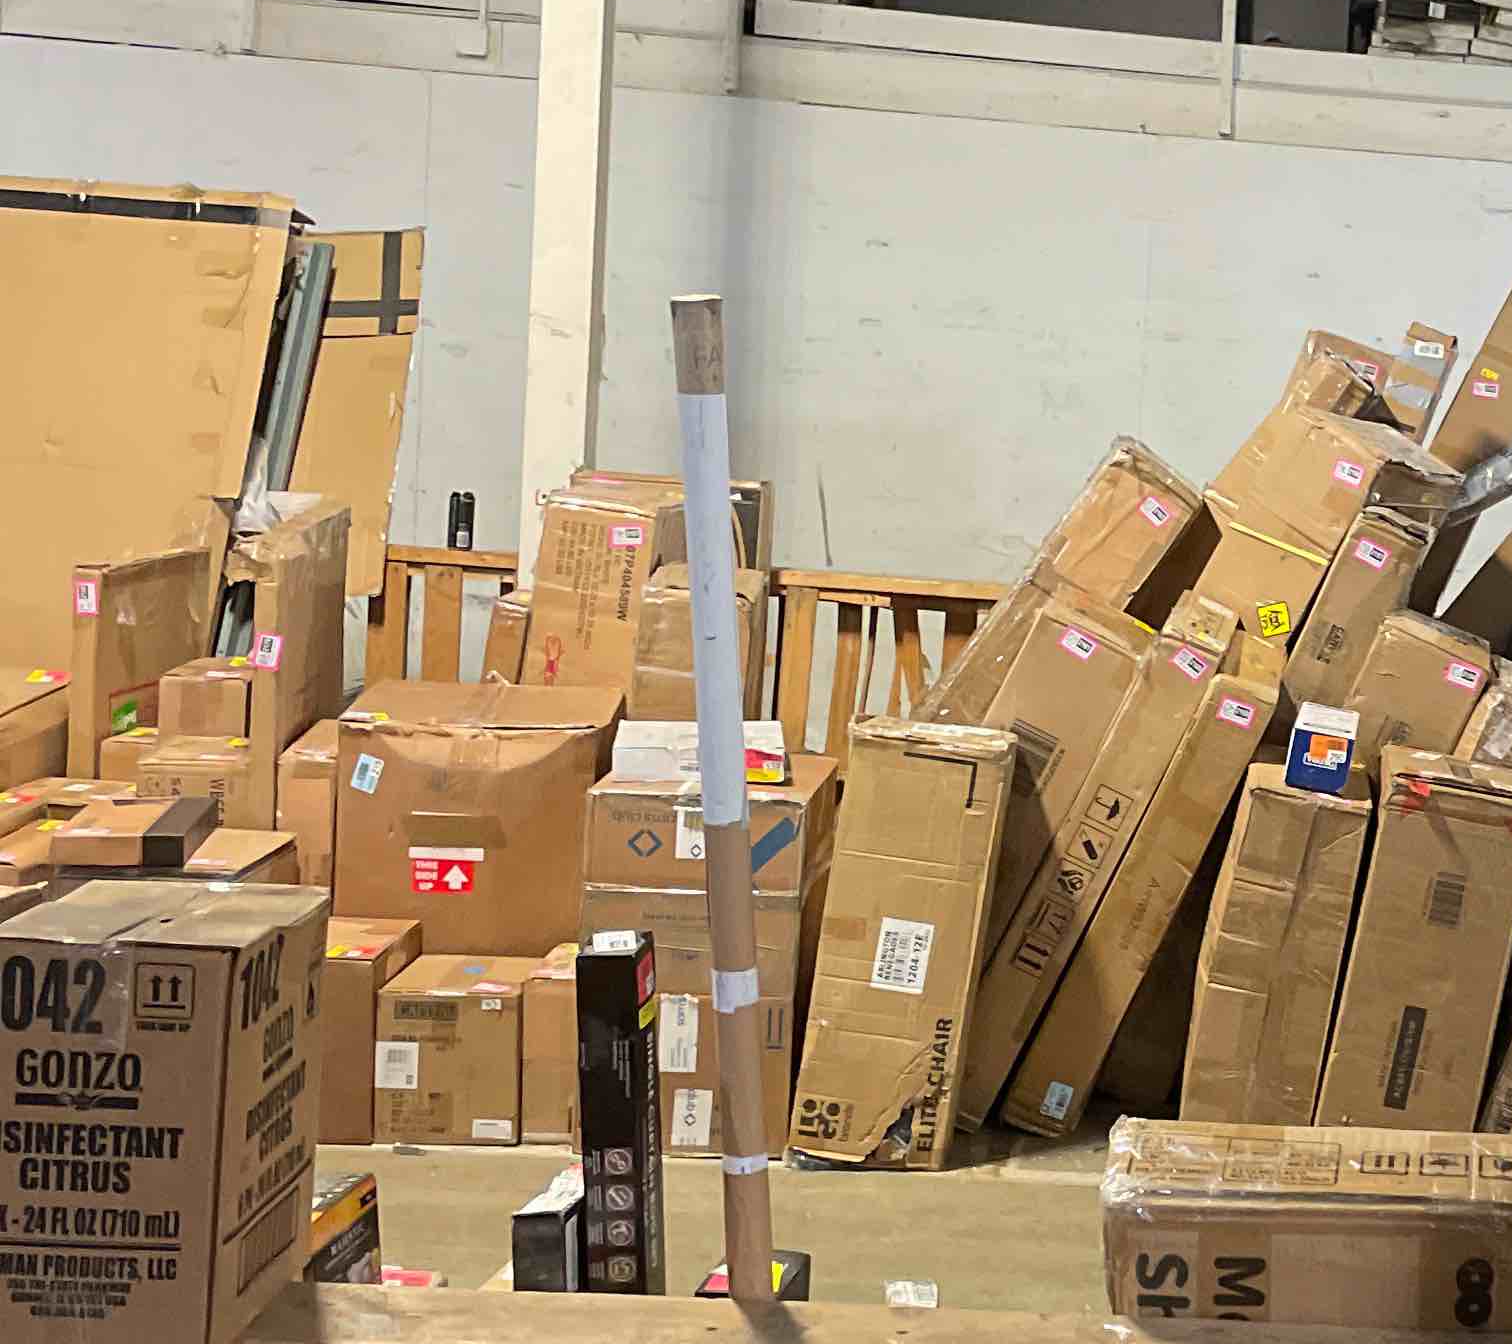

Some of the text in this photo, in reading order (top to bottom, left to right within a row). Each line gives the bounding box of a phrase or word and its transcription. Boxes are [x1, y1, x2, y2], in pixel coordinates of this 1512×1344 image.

[240, 932, 285, 1031] 1042
[927, 1017, 954, 1086] CHAIR
[0, 1119, 185, 1160] SINFECTANT
[19, 1157, 132, 1194] CITRUS
[23, 1205, 47, 1235] 24
[74, 1207, 98, 1237] OZ
[101, 1208, 141, 1239] (710
[43, 1254, 143, 1284] PRODUCTS,
[147, 1257, 178, 1282] LLC
[1212, 1256, 1268, 1322] M
